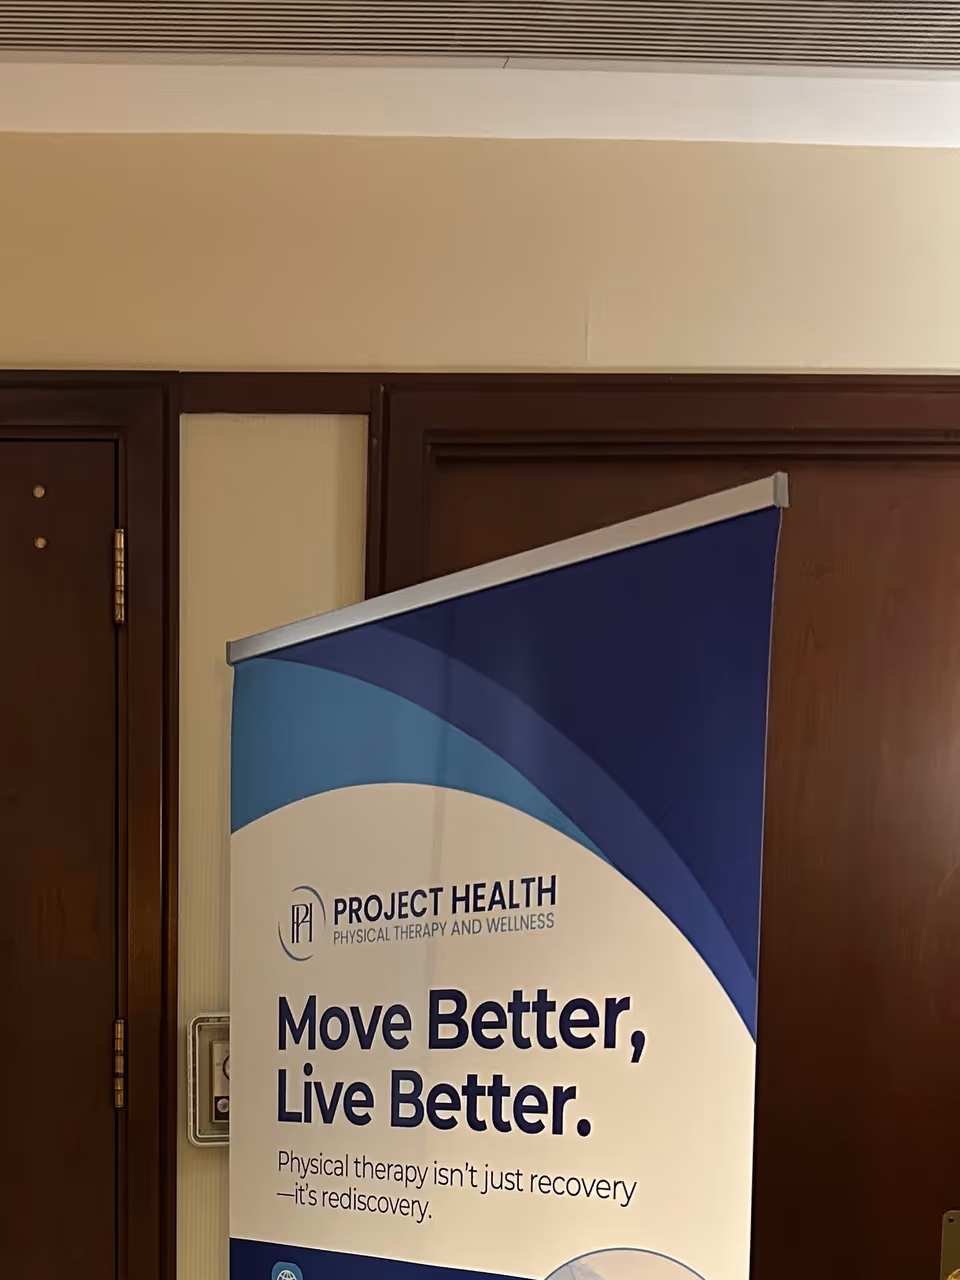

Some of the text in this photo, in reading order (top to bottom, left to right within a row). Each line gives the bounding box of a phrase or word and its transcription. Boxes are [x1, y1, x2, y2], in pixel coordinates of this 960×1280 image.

[334, 875, 557, 925] PROJECT HEALTH
[333, 912, 554, 945] PHYSICAL THERAPY AND WELLNESS
[278, 988, 645, 1063] Move Better,
[277, 1062, 591, 1137] Live Better.
[278, 1151, 637, 1207] Physical therapy isn't just recovery
[322, 1188, 432, 1223] rediscovery.
